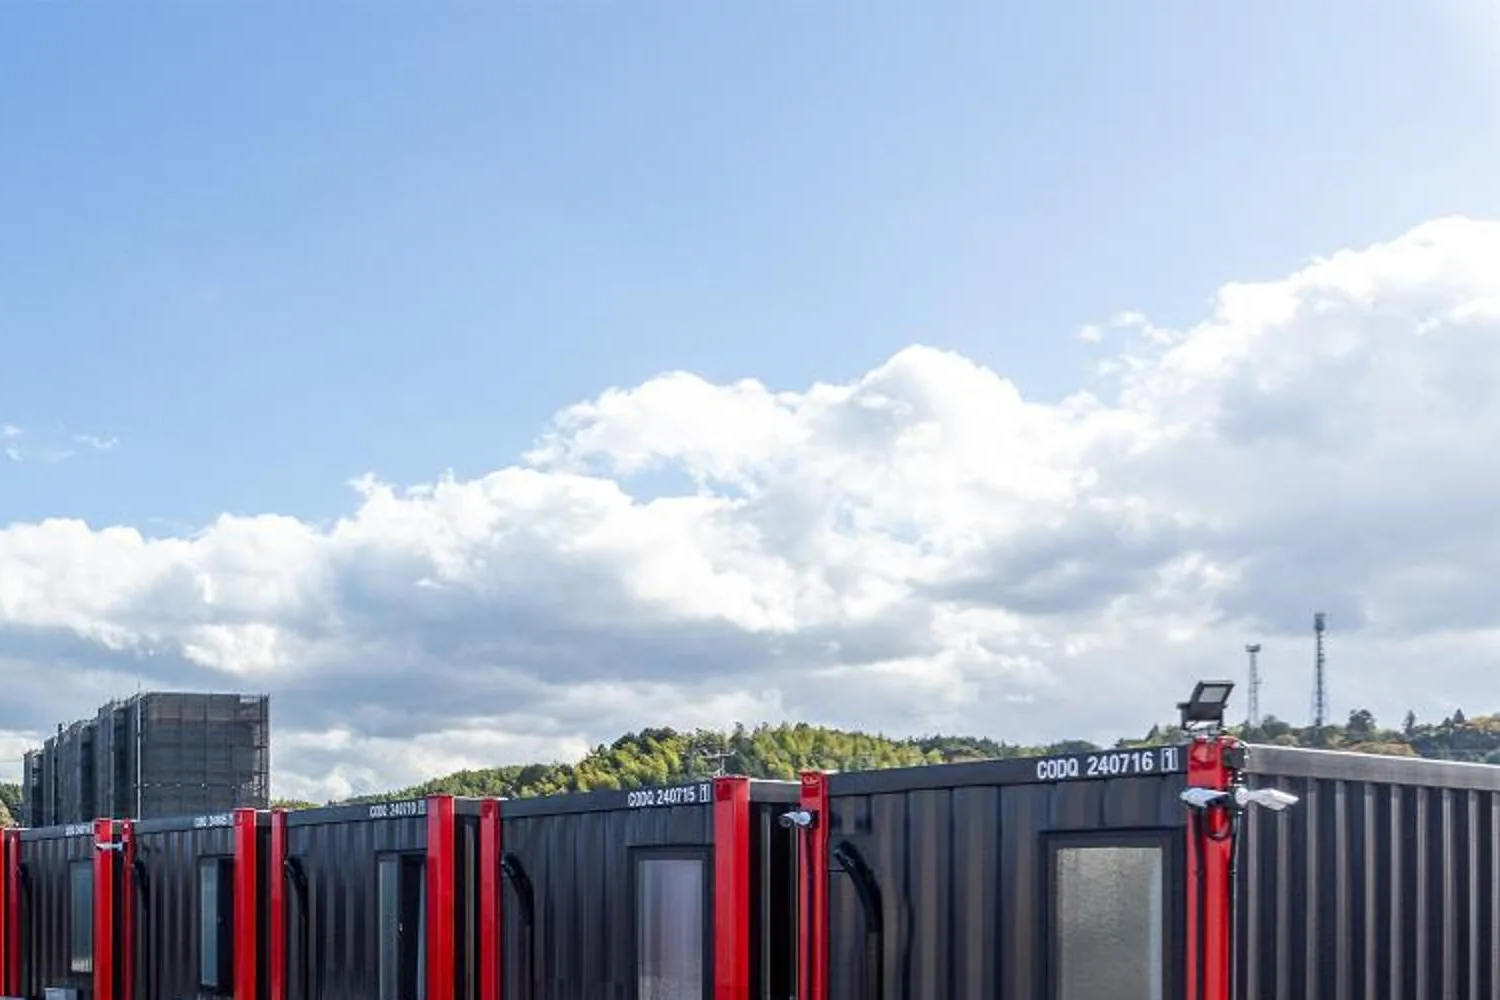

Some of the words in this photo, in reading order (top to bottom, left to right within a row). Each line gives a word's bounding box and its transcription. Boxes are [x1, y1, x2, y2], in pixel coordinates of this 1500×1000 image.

[1037, 758, 1079, 779] CODQ
[1086, 752, 1153, 776] 240716
[656, 786, 696, 804] 240715
